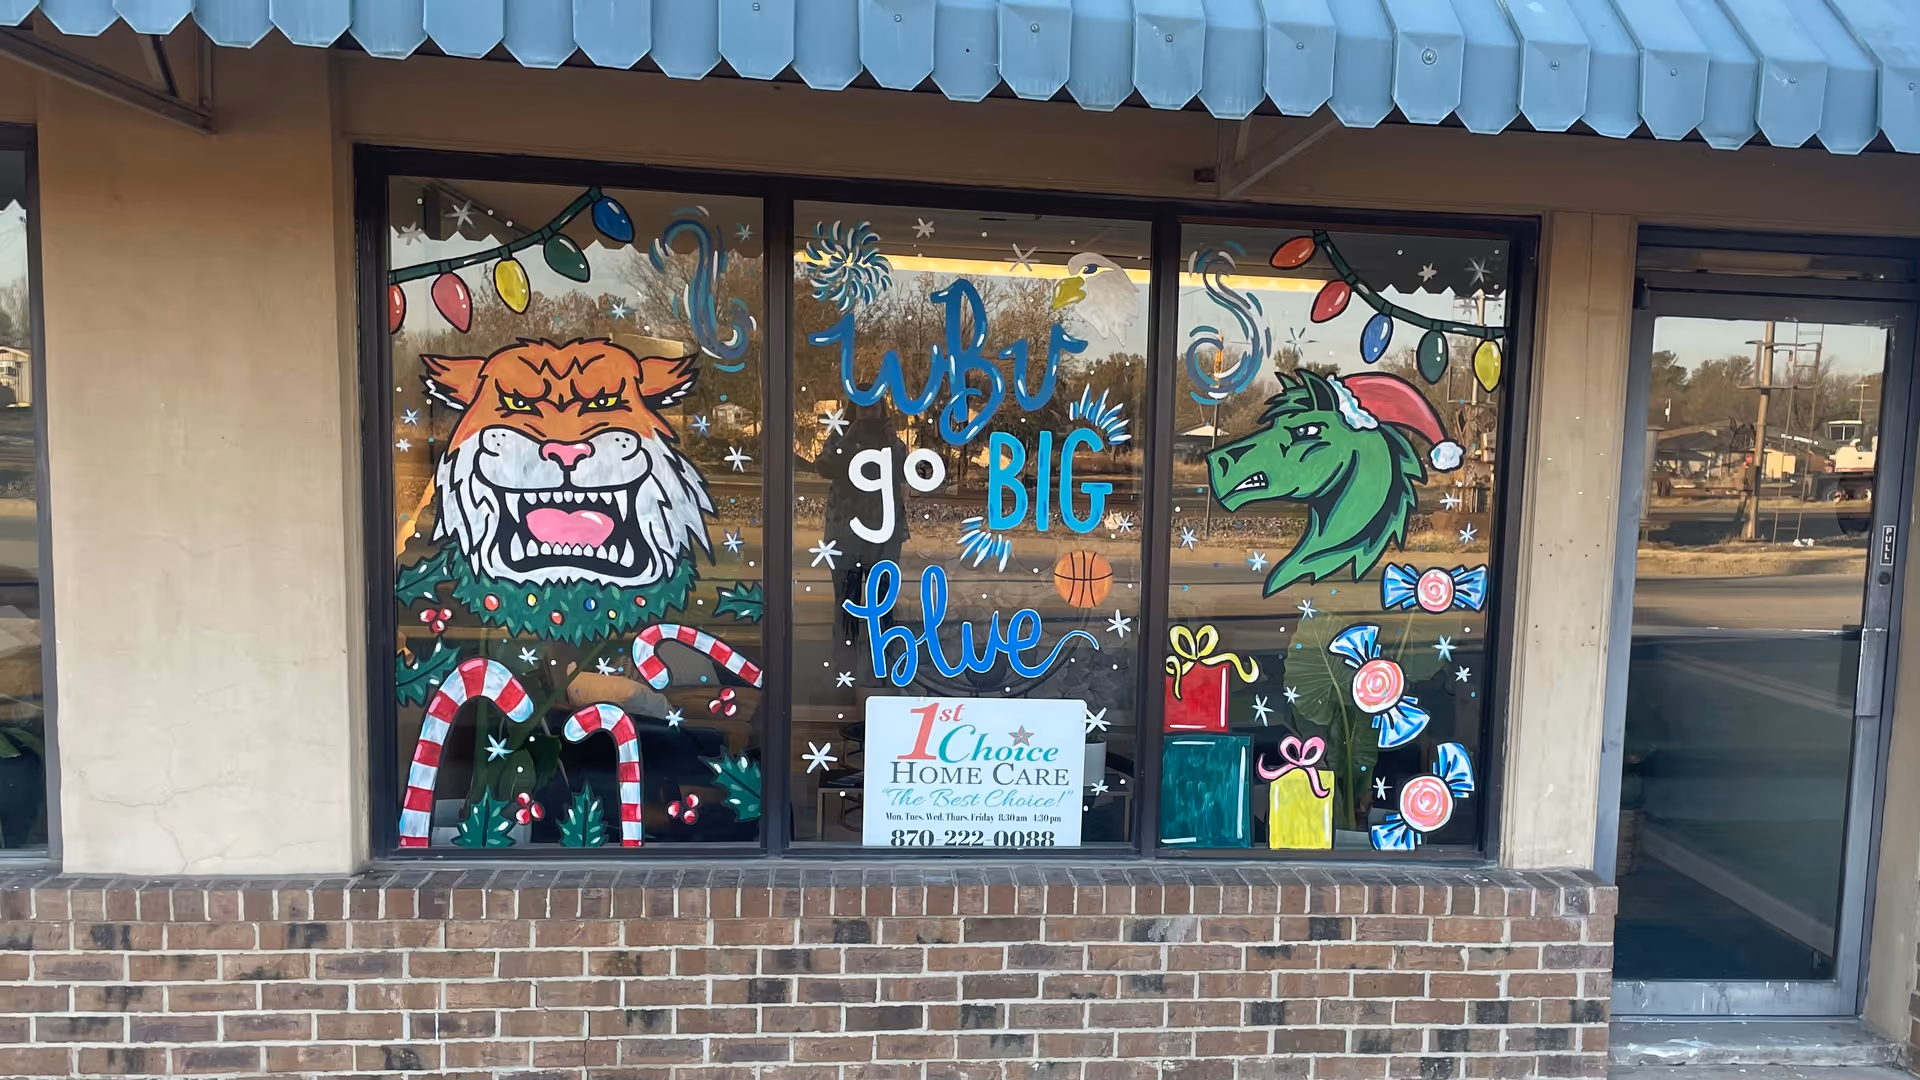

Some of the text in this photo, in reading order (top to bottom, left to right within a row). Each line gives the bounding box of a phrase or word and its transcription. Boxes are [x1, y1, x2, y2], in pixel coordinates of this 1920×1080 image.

[848, 429, 1113, 544] go BIG
[1884, 527, 1893, 560] PULL
[842, 559, 1099, 688] blue
[897, 702, 965, 760] 1st
[938, 724, 1059, 764] Choice
[929, 788, 981, 807] Best
[890, 829, 1055, 847] 870-222-0088
